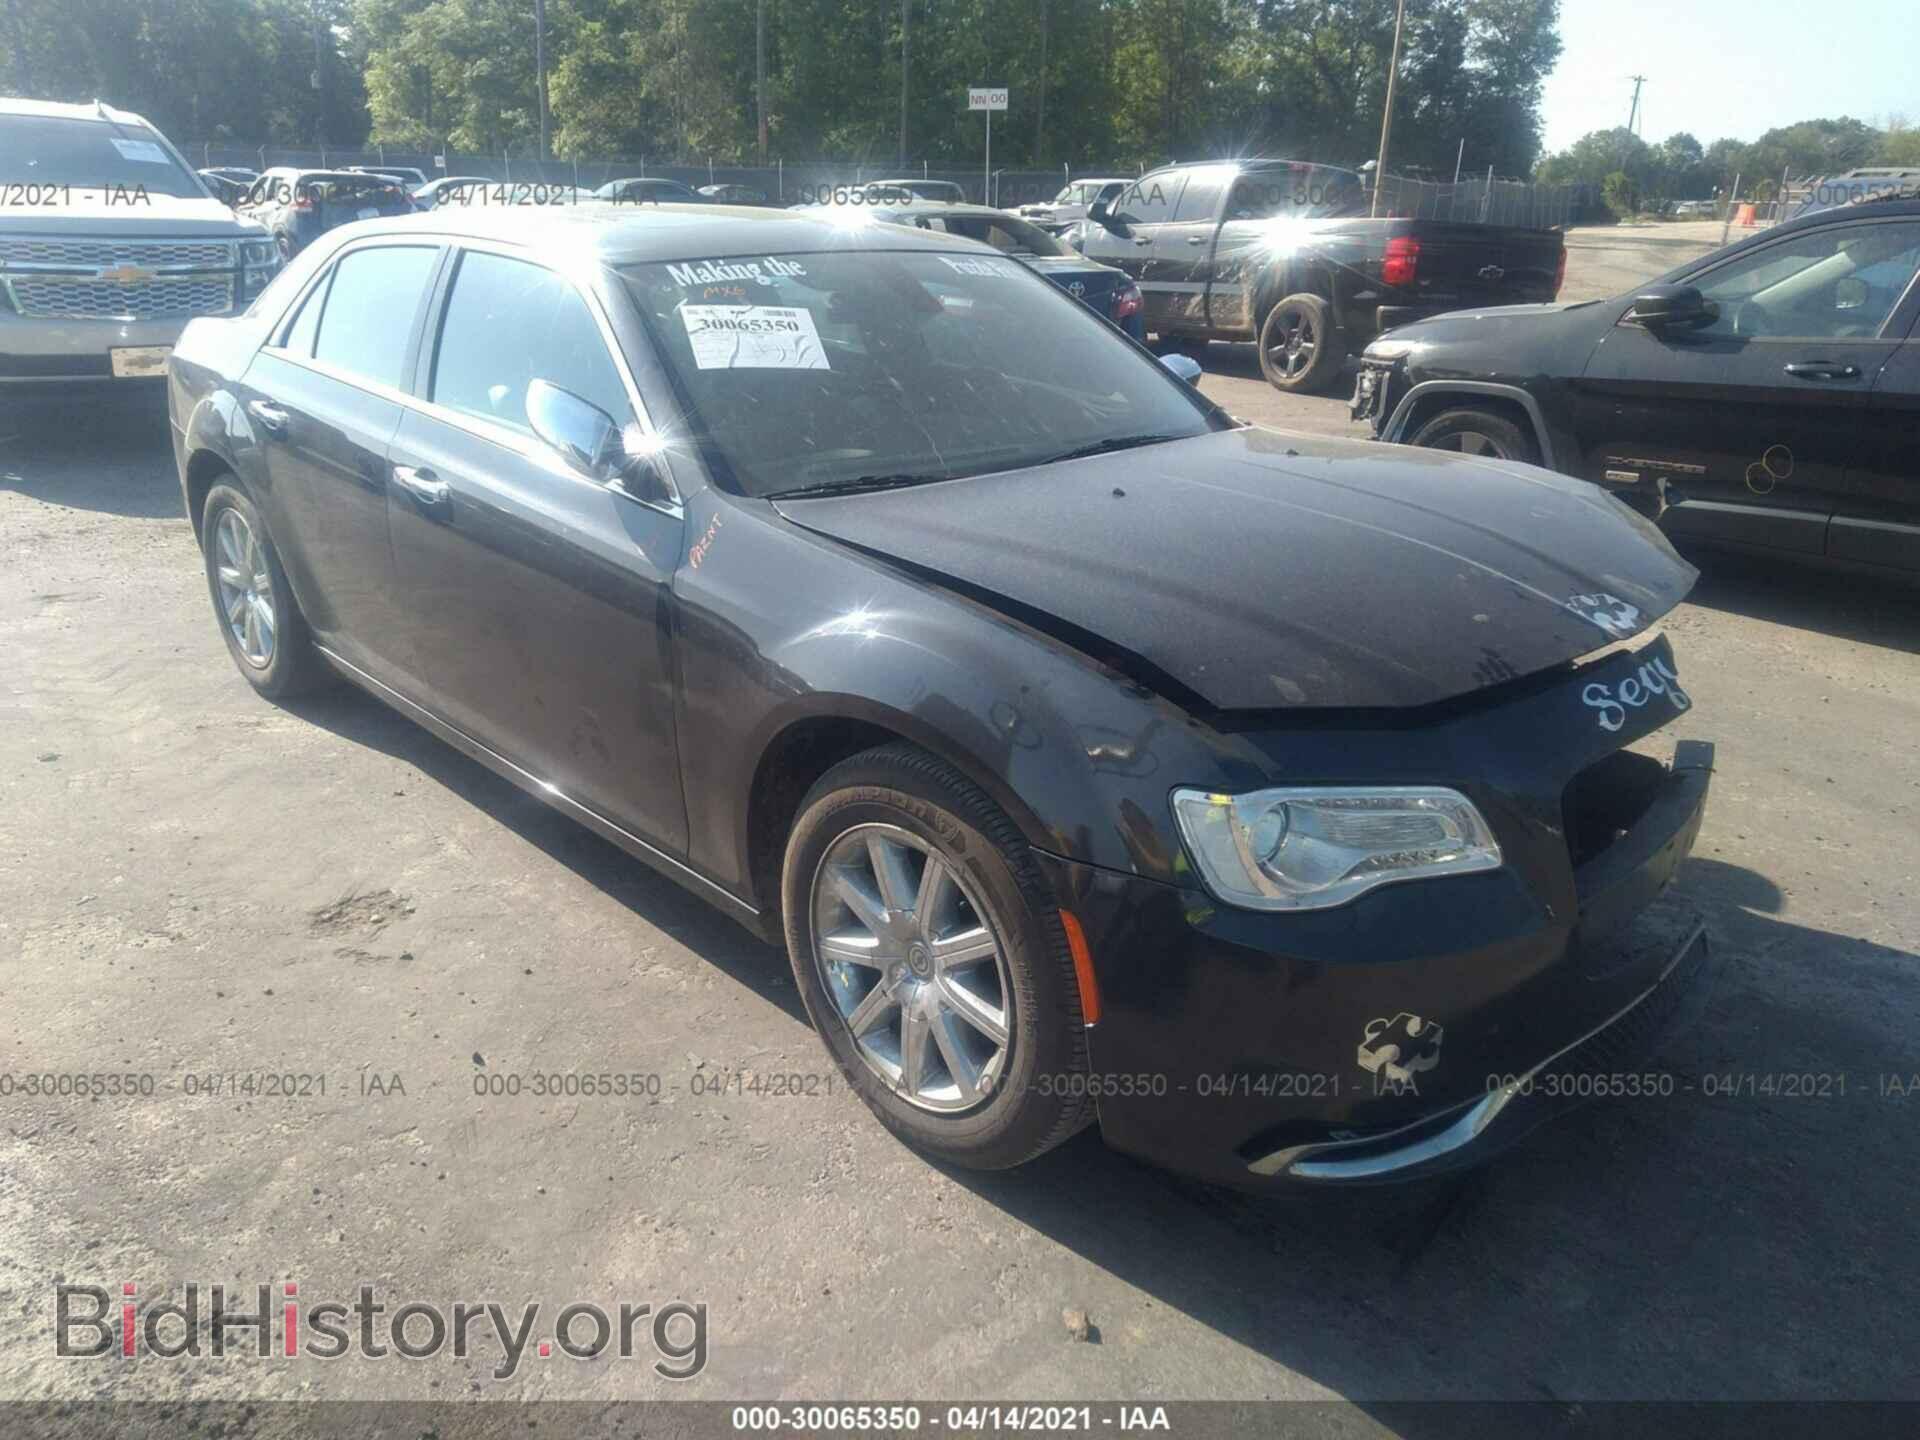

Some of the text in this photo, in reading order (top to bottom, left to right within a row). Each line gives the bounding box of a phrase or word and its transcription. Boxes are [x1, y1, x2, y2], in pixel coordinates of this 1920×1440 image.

[666, 256, 807, 286] Making the
[699, 318, 800, 333] 30065350
